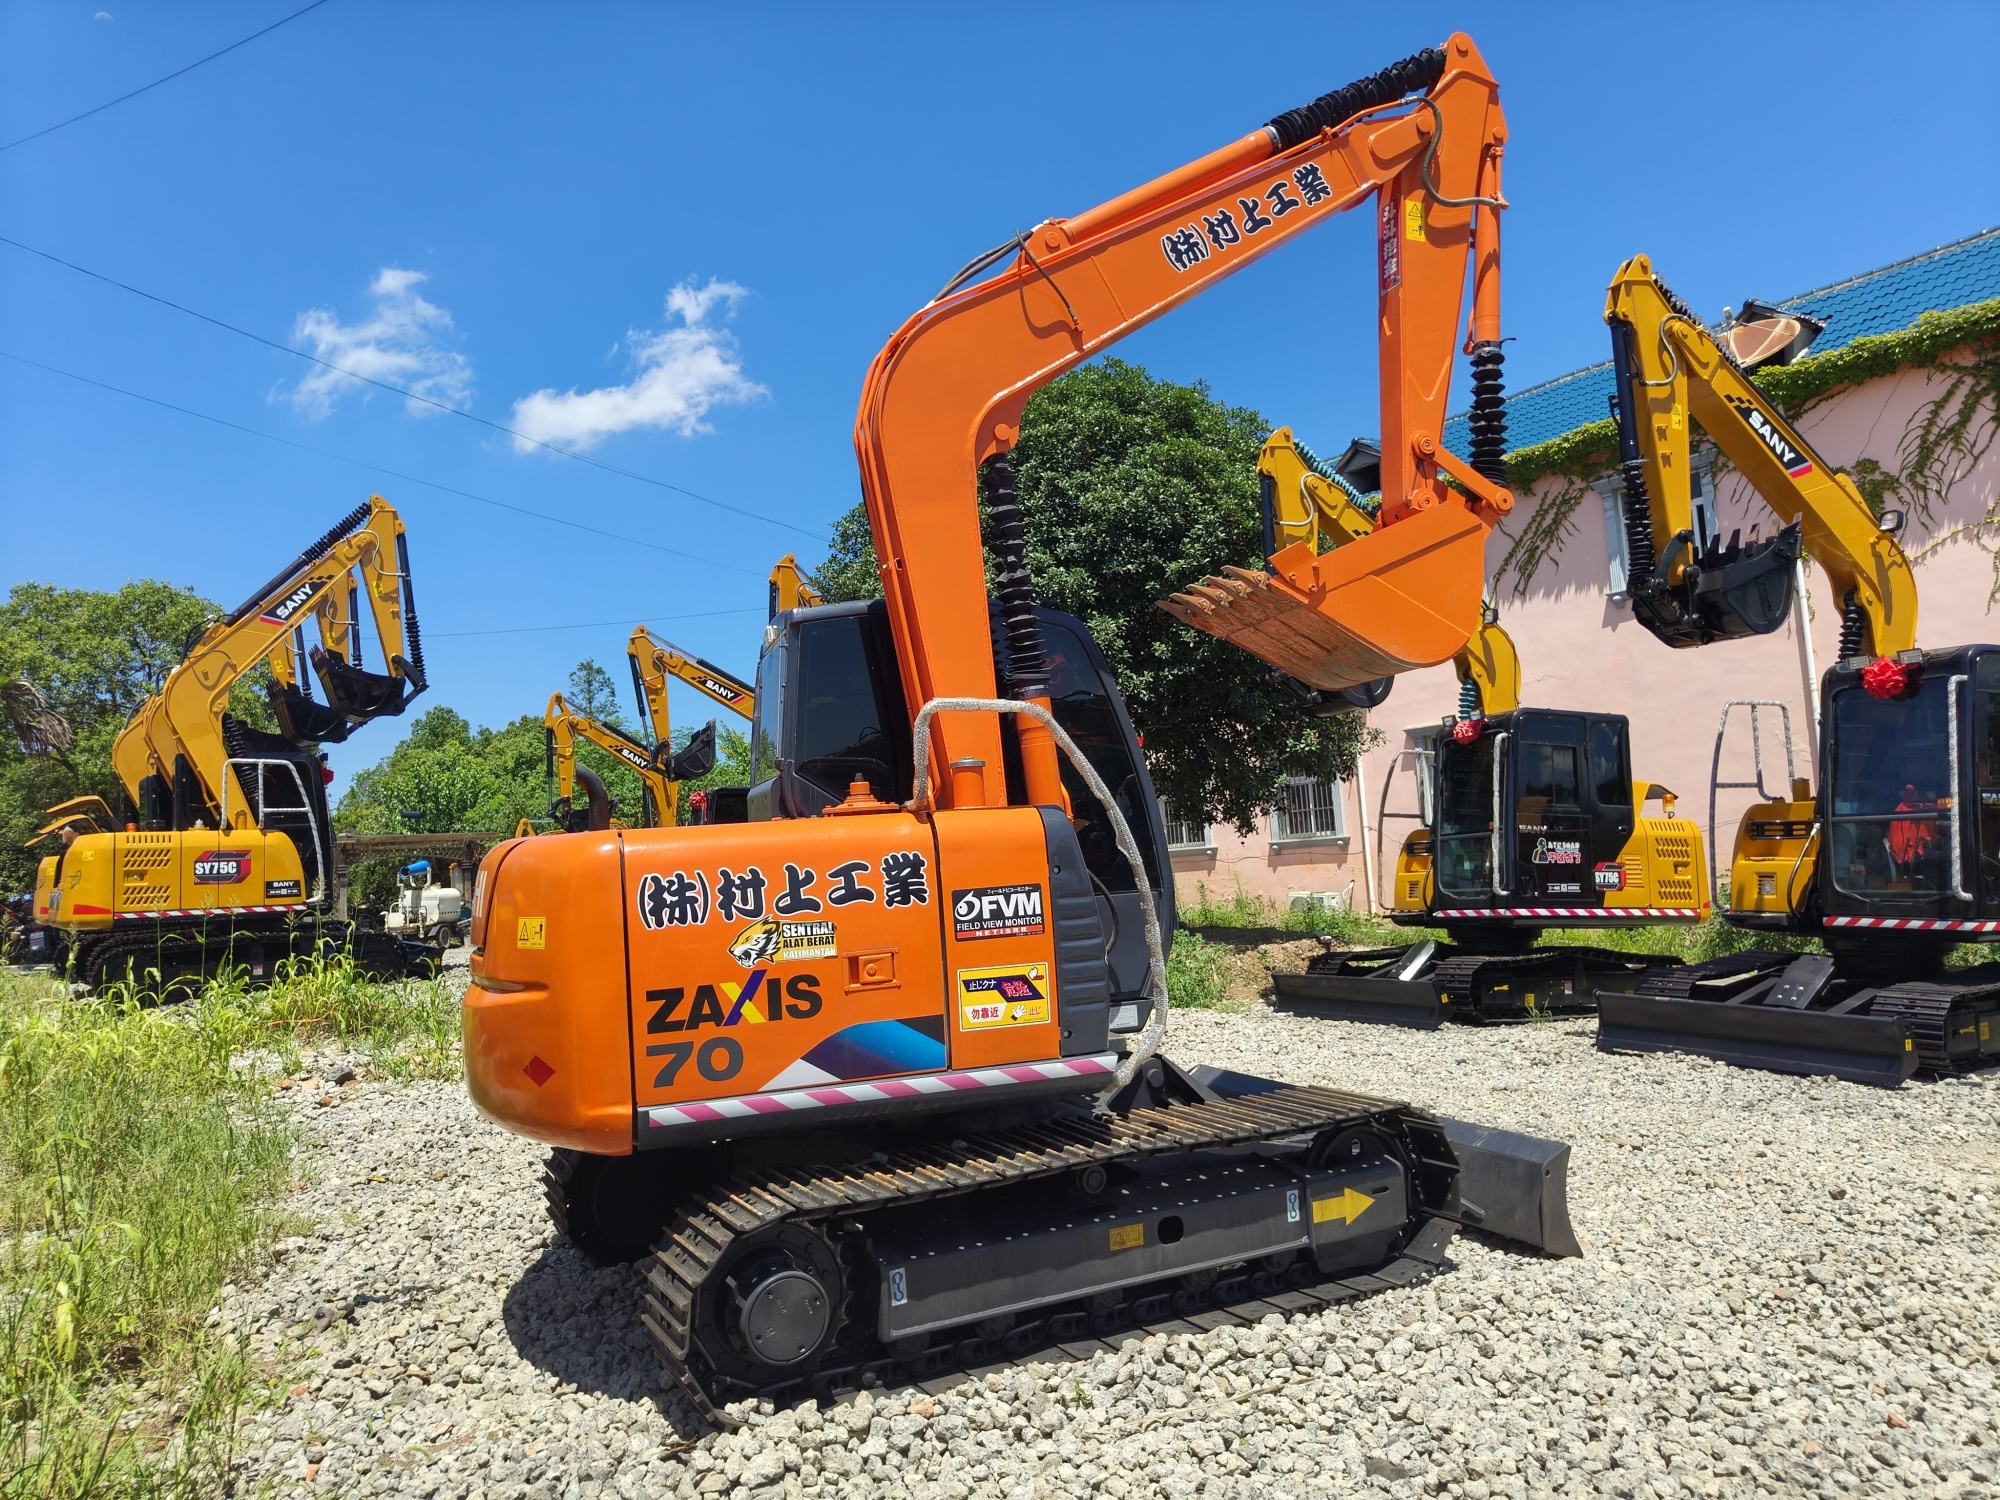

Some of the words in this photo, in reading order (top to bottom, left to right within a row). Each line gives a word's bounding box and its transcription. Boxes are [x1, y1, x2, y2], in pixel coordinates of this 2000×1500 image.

[1748, 410, 1796, 463] SANY
[275, 583, 313, 619] SANY
[705, 679, 736, 699] SANY
[621, 748, 648, 768] SANY
[195, 861, 238, 875] SY75C
[1595, 871, 1620, 884] SY75C
[638, 852, 928, 929] (株)村上工業
[981, 892, 1042, 919] FVM
[783, 921, 835, 938] SENTRAL
[956, 922, 981, 931] FIELD
[982, 920, 1003, 929] VIEW
[1005, 917, 1042, 927] MONITOR
[783, 938, 806, 949] ALAT
[807, 936, 835, 947] BERAT
[783, 947, 837, 960] KALIMANTAN
[646, 969, 822, 1034] ZAXIS
[971, 1006, 999, 1020] 勿靠近
[646, 1036, 744, 1088] 70
